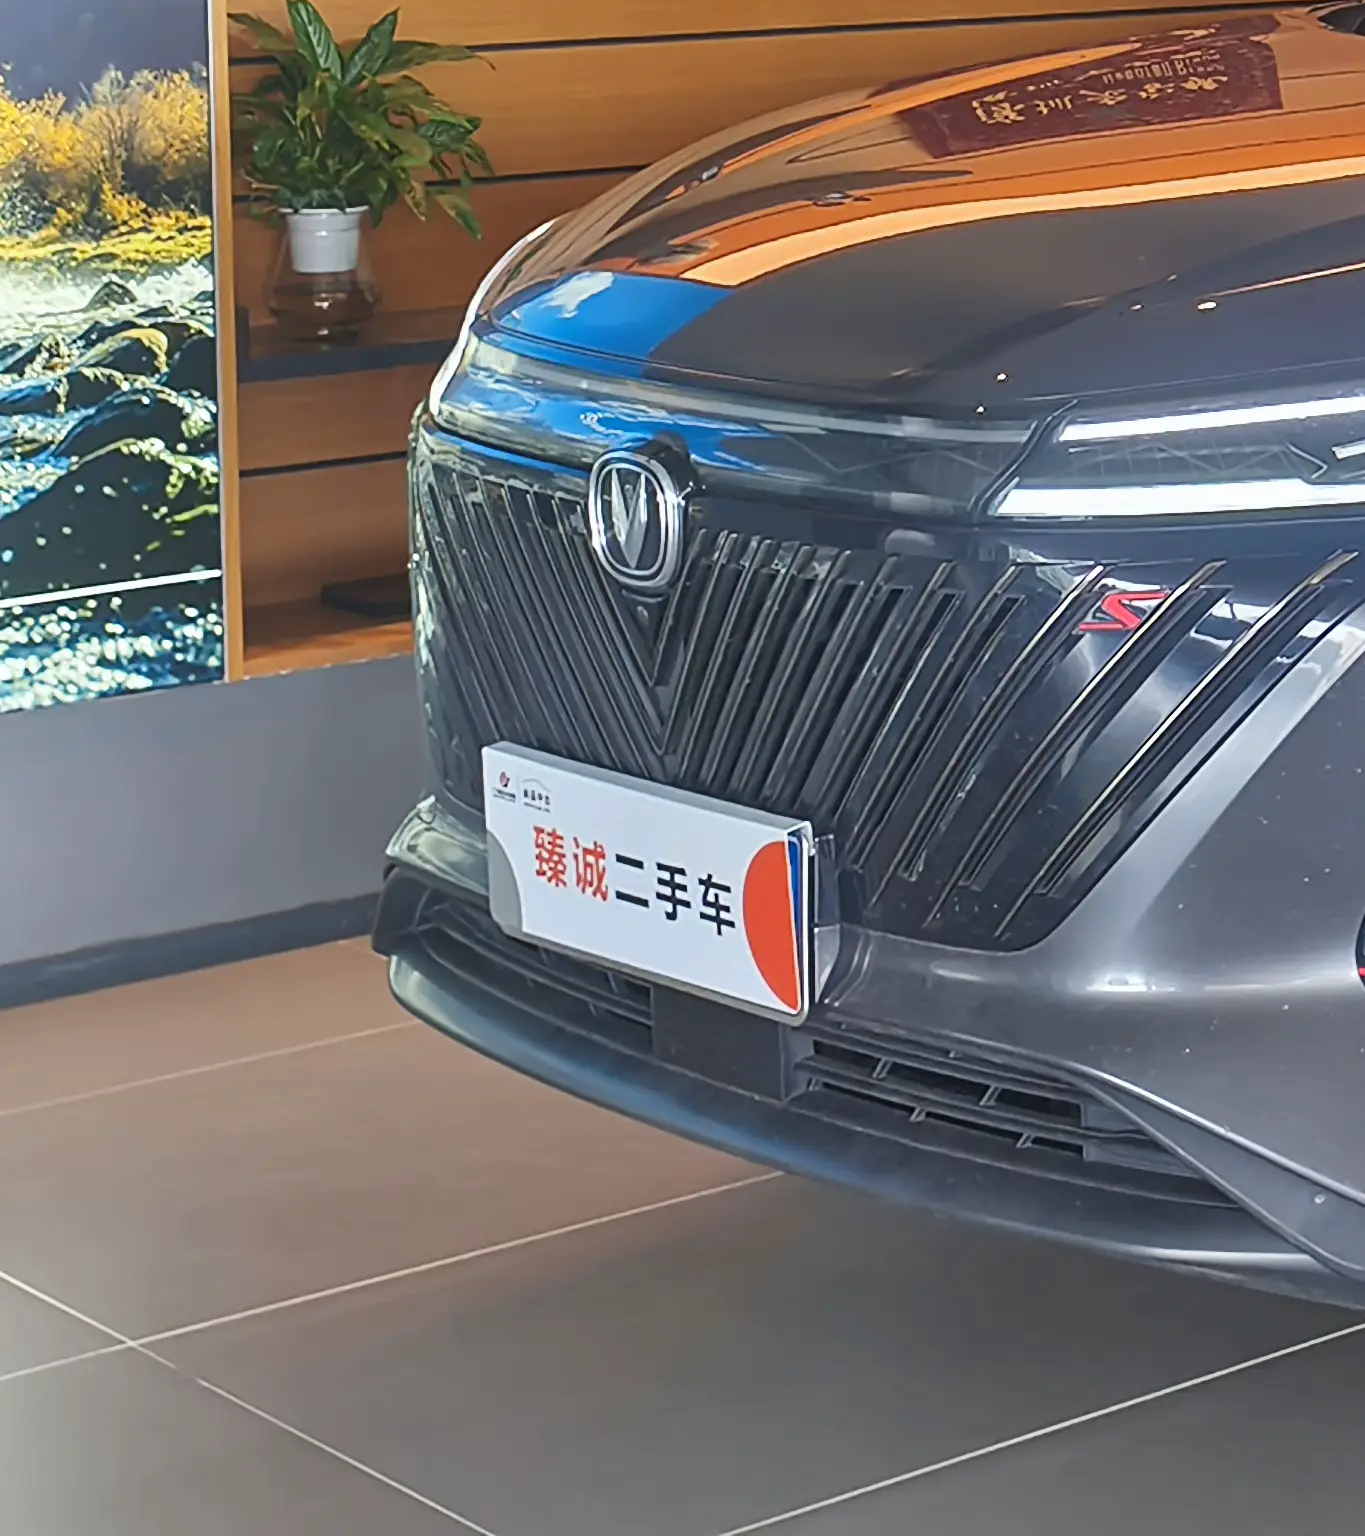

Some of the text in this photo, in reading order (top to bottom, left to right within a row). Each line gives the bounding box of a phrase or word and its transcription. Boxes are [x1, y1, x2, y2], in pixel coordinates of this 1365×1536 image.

[532, 824, 737, 937] 臻诚二手车
